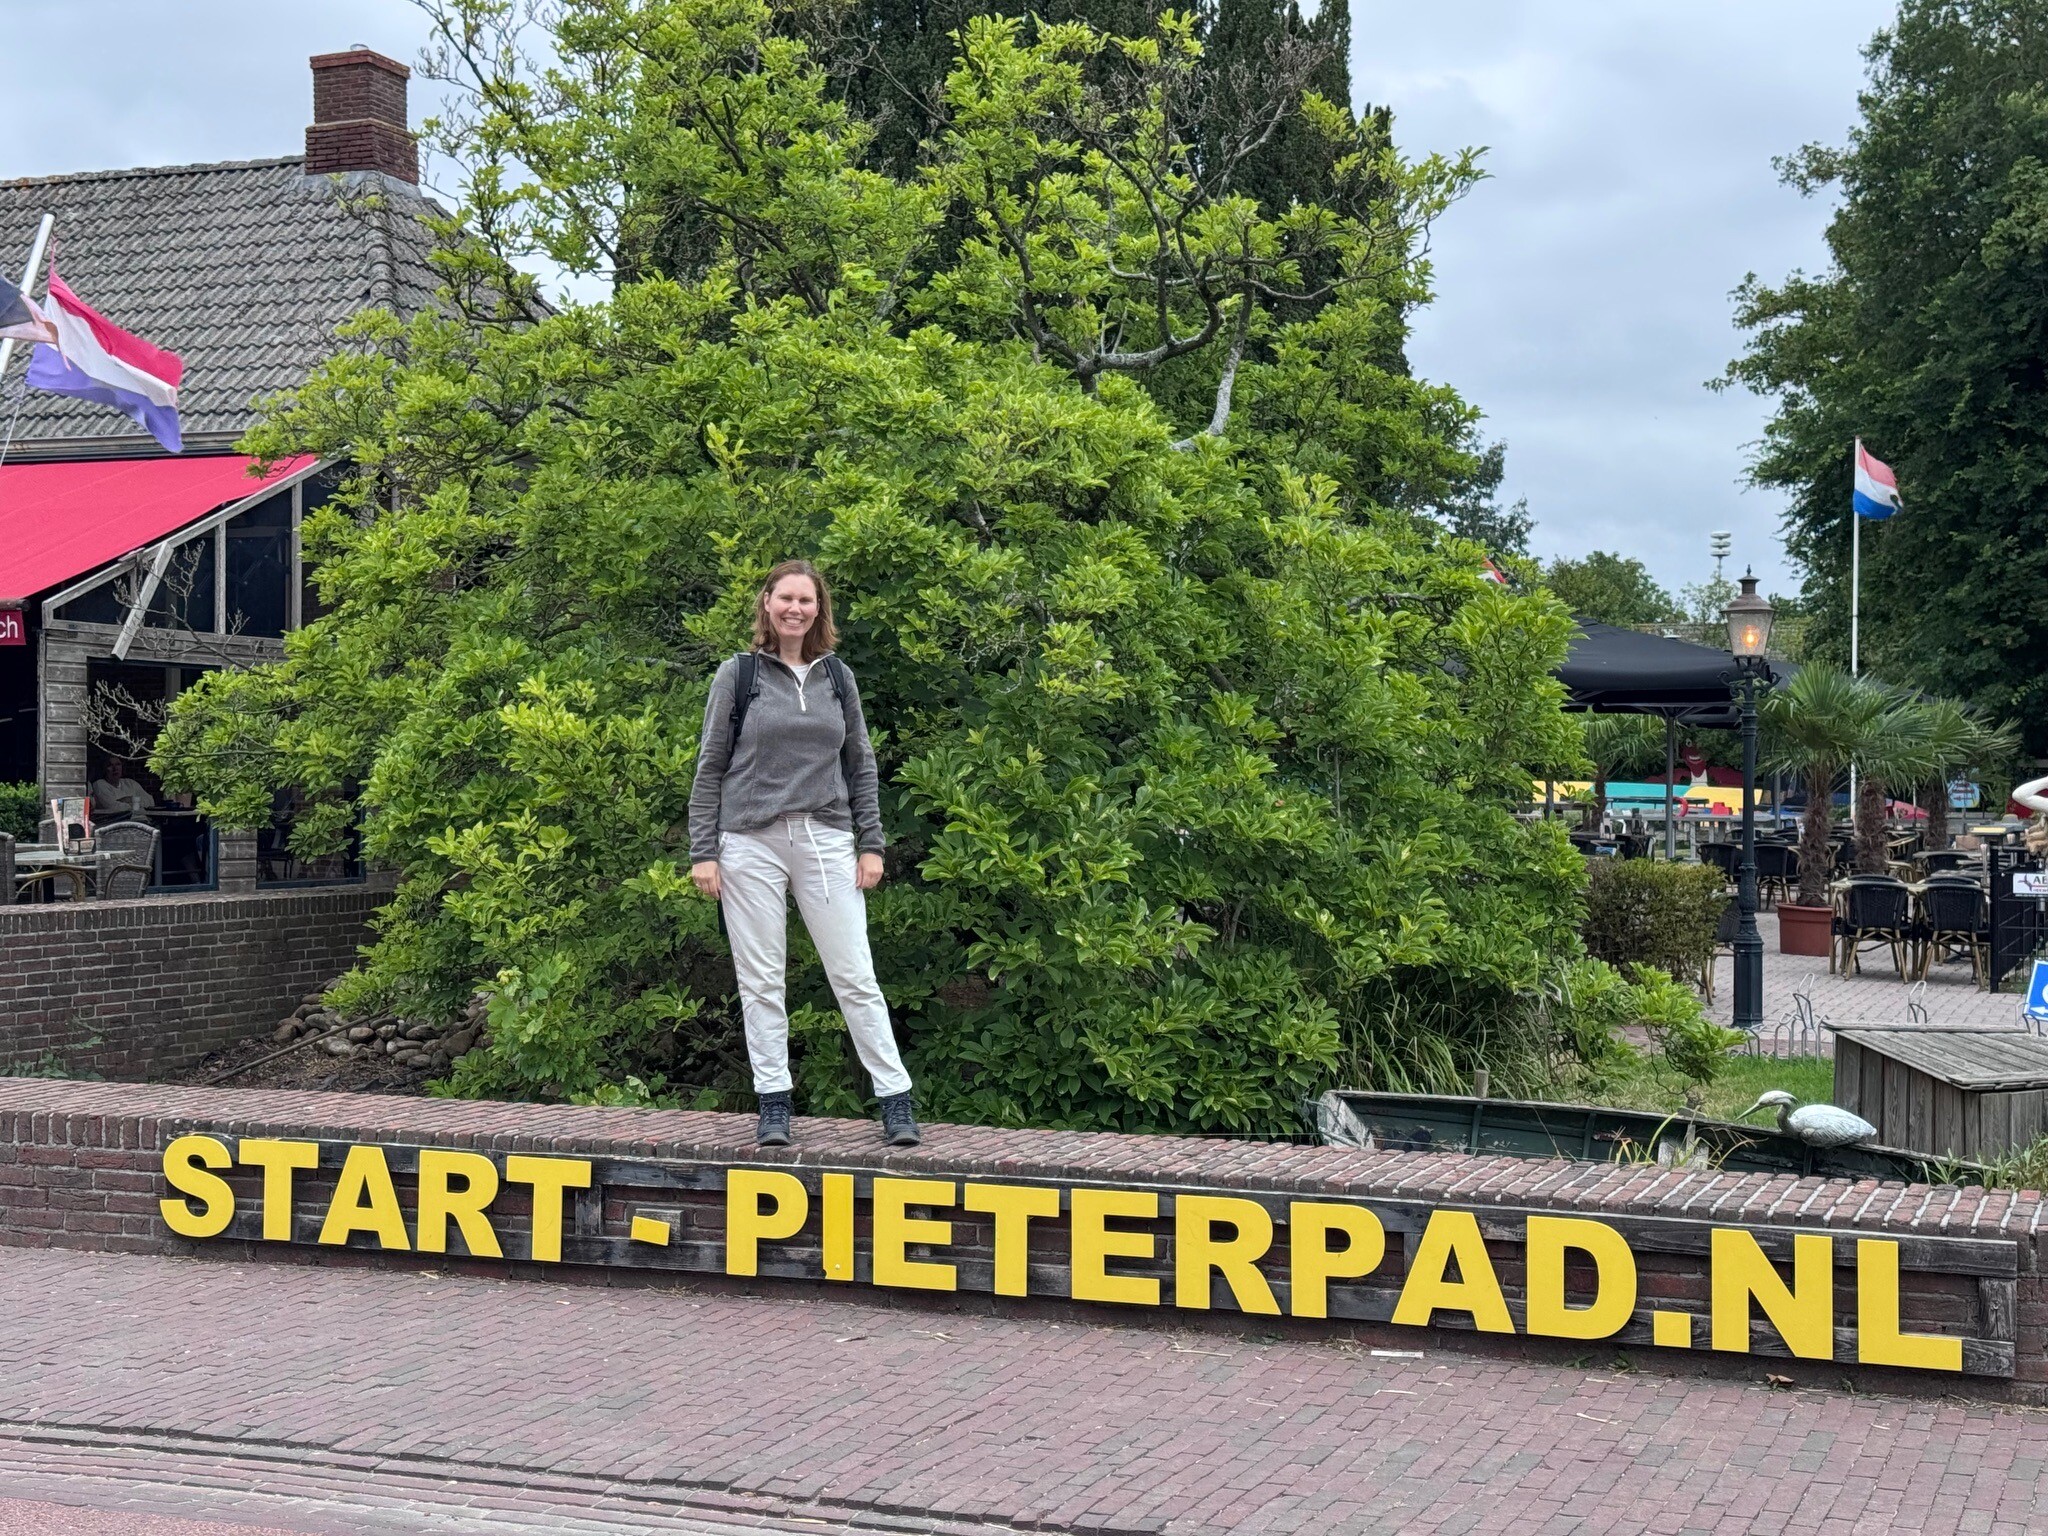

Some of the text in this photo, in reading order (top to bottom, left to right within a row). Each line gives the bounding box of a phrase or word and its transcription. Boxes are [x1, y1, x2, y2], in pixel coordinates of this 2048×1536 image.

[160, 1134, 1963, 1370] START - PIETERPAD.NL
